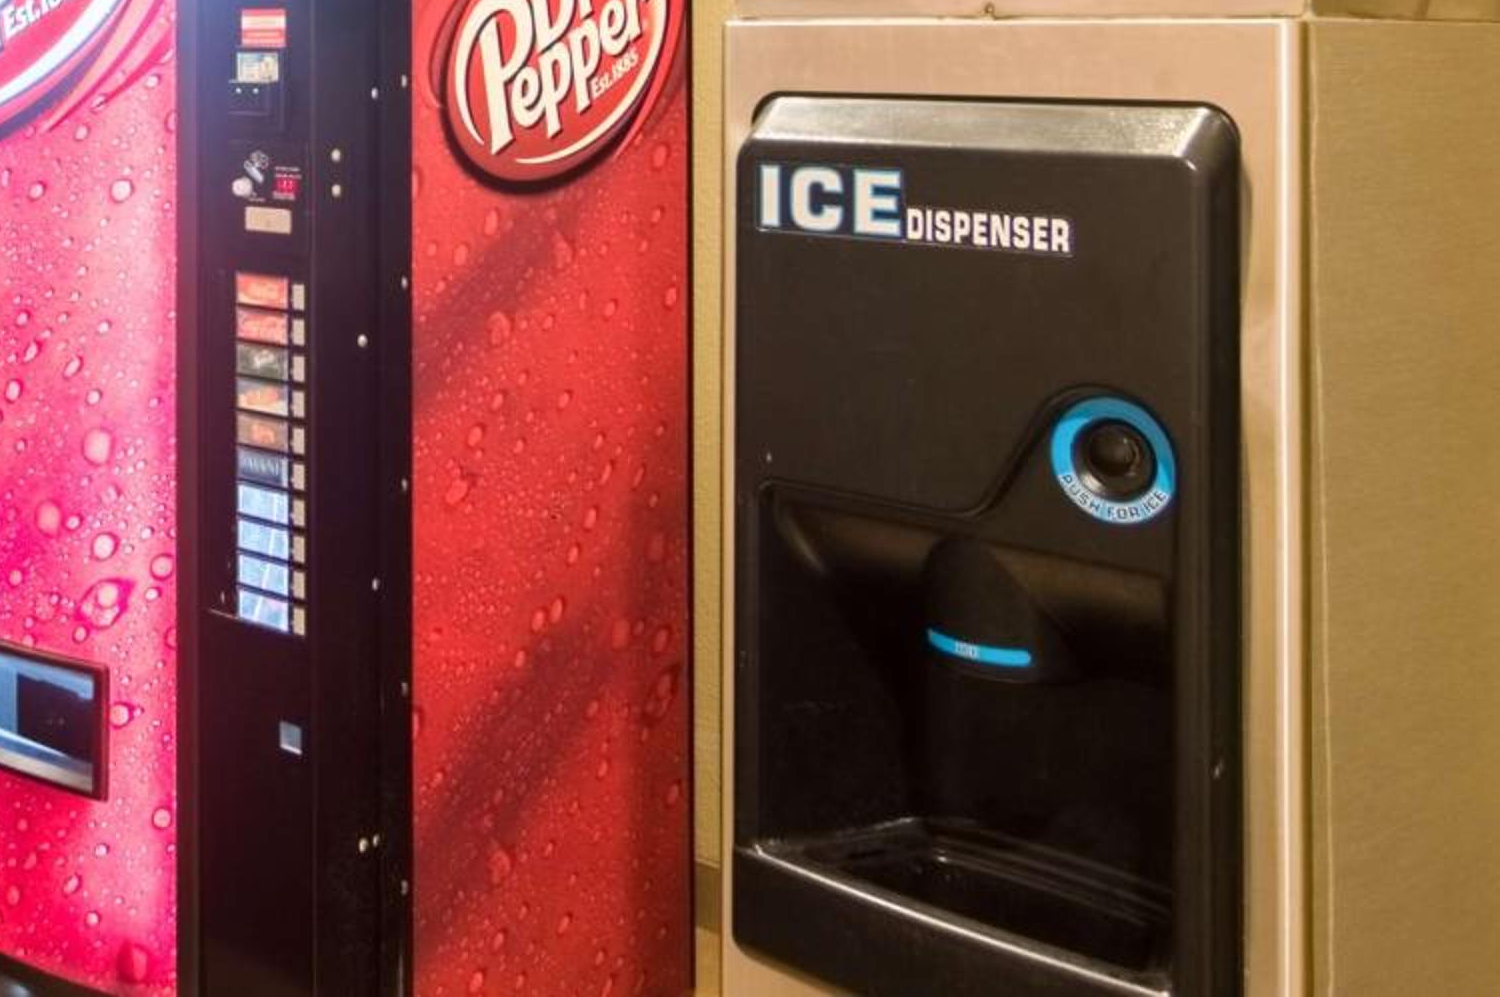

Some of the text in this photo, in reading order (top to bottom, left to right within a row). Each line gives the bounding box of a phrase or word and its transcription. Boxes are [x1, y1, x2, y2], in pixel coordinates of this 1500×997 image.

[760, 164, 1070, 253] ICE DISPENSER
[1062, 474, 1167, 520] PUSH FOR ICE
